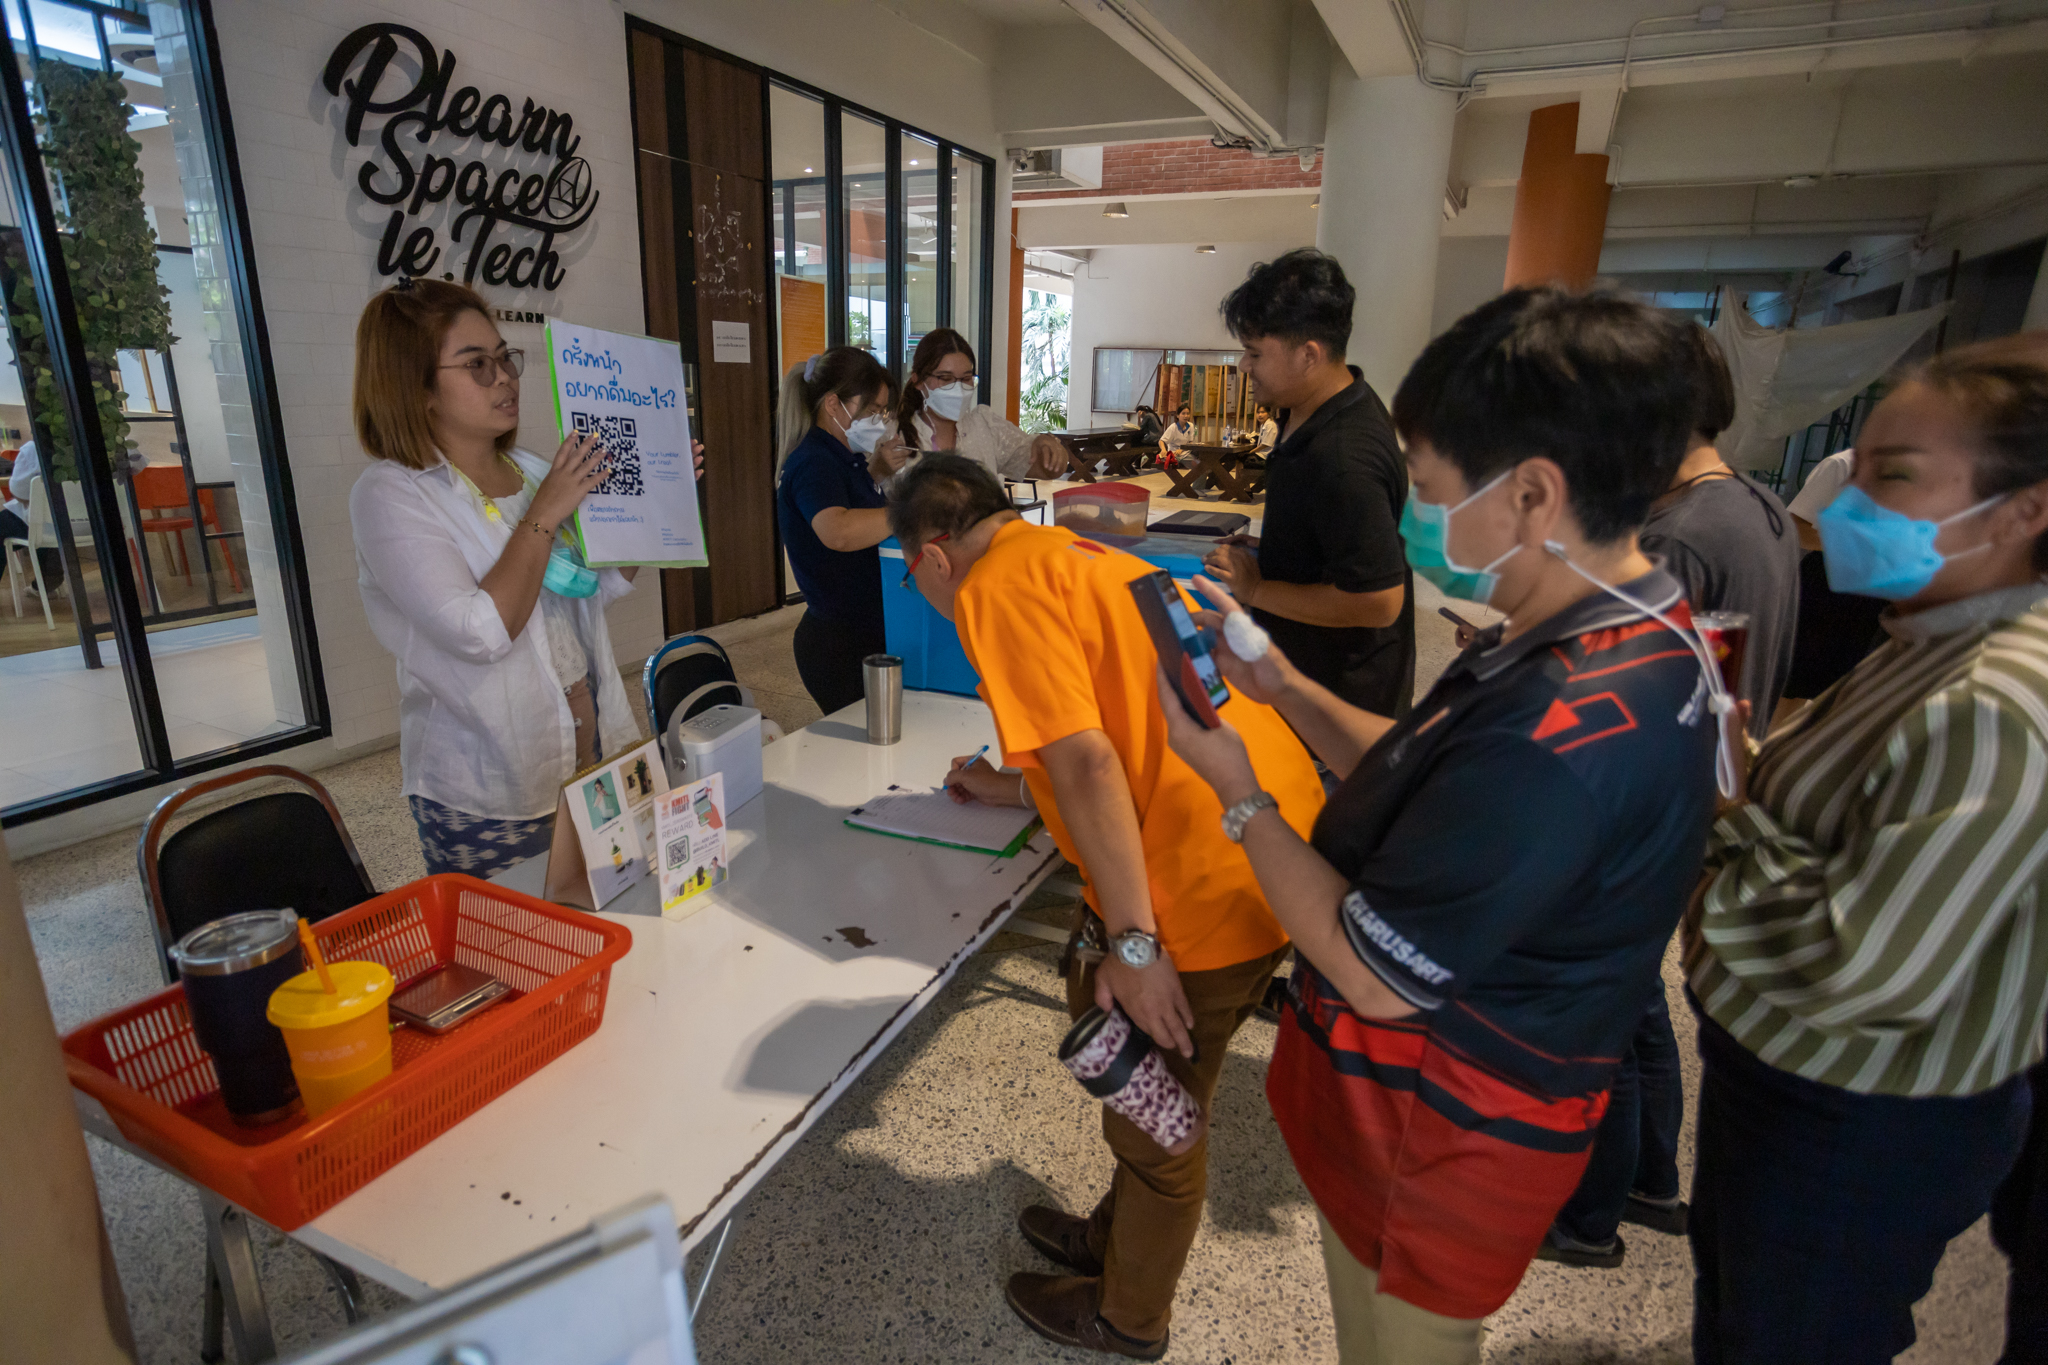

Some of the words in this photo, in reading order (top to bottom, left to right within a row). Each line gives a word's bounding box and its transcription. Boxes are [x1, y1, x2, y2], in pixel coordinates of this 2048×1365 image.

[323, 22, 581, 157] Plearn
[358, 110, 550, 217] Space
[496, 309, 545, 324] LEARN
[661, 820, 694, 840] REWARD
